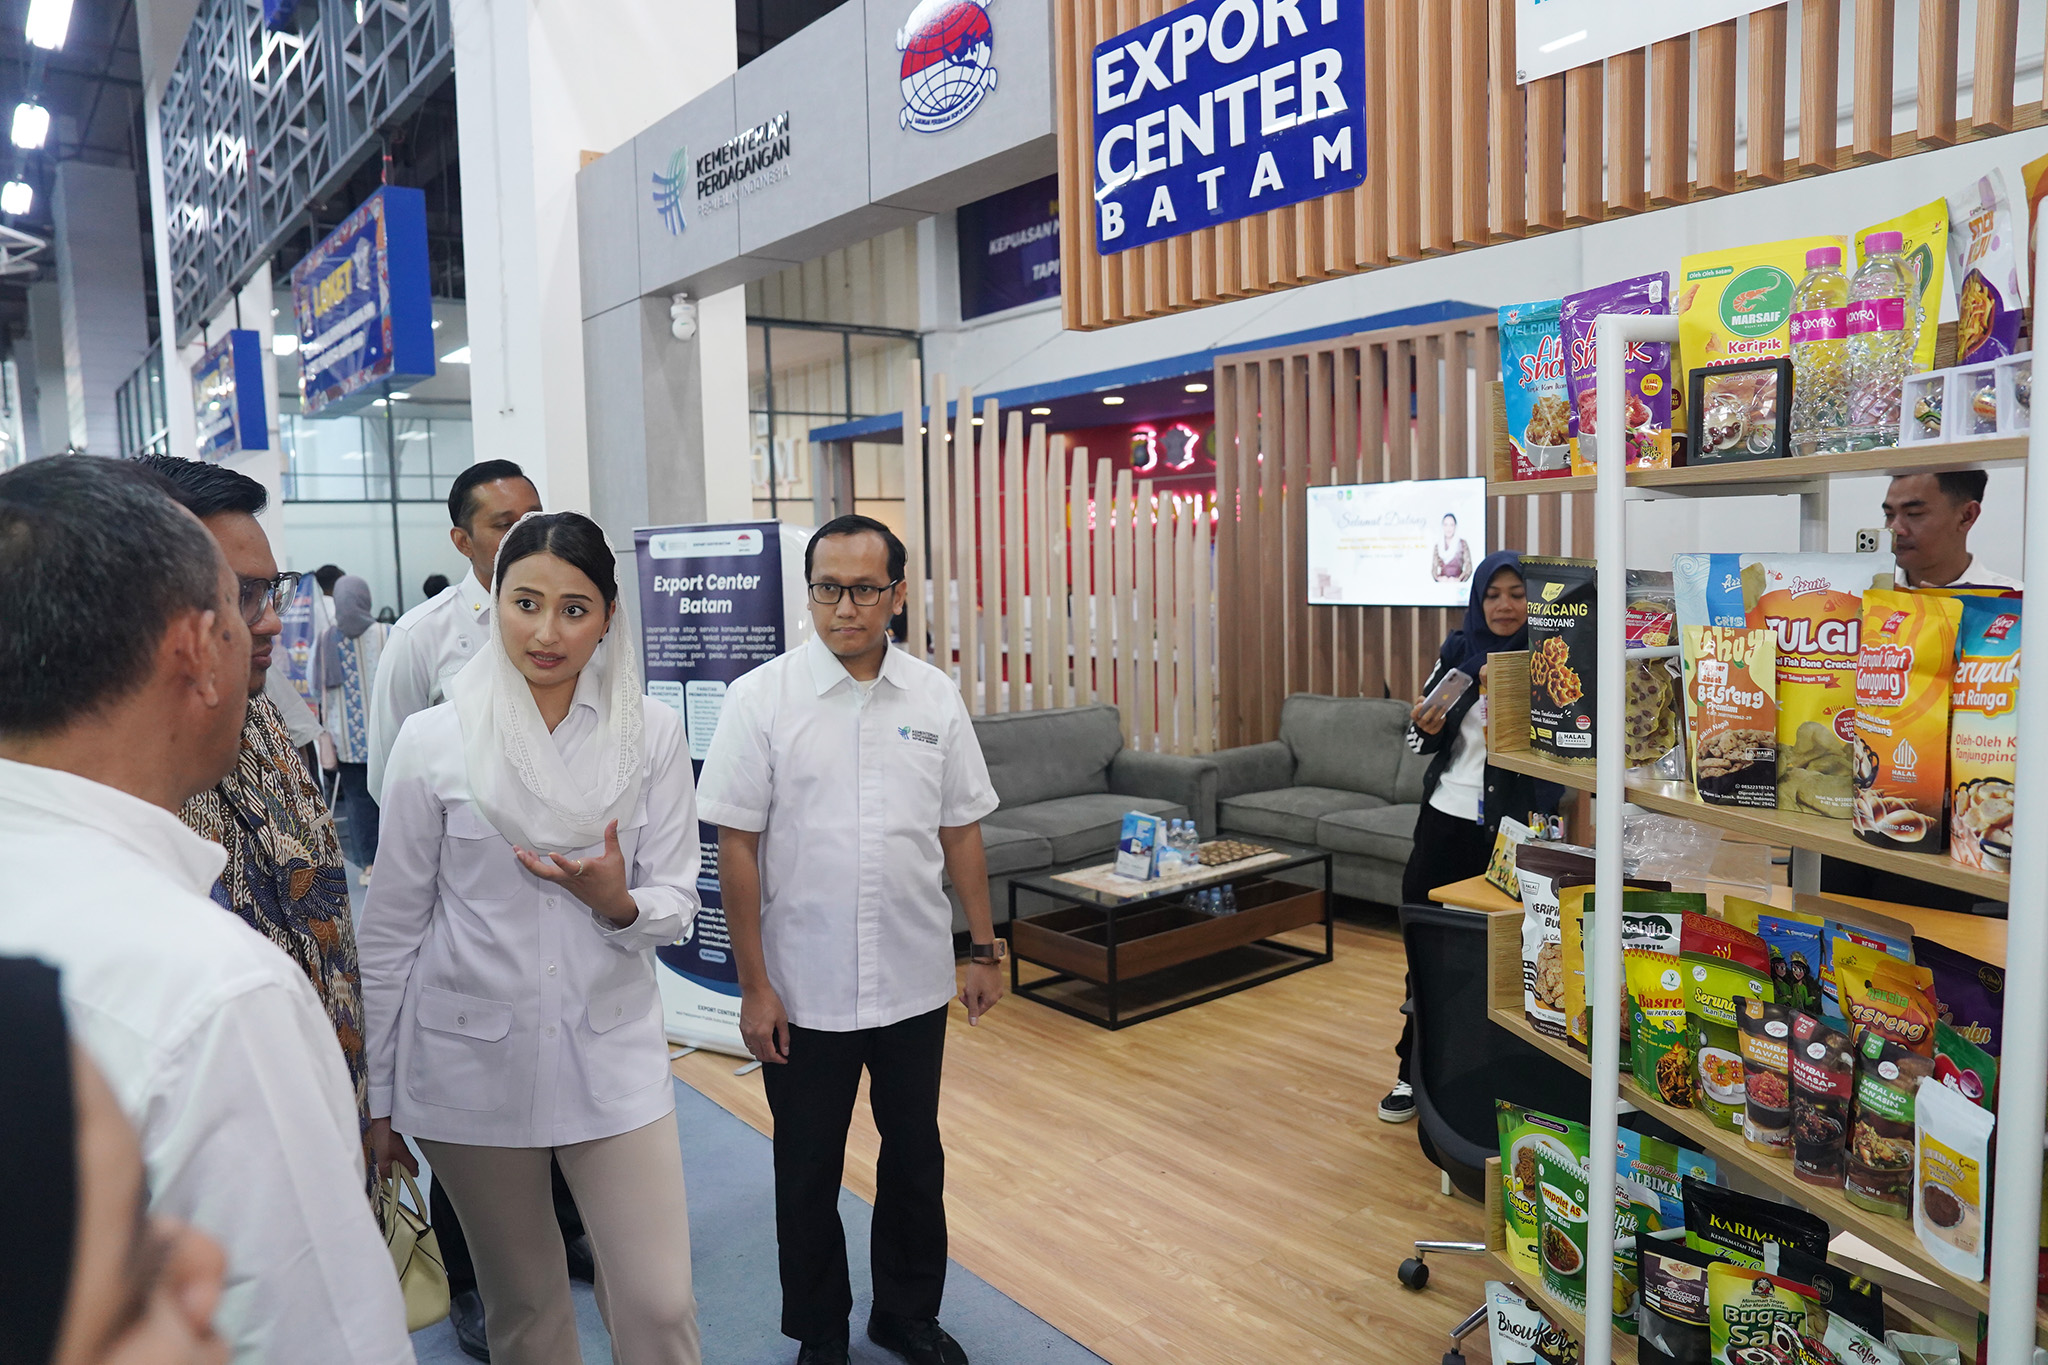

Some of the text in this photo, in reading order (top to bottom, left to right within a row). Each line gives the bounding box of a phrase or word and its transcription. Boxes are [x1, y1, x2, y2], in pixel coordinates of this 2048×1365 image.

[1097, 48, 1349, 187] CENTER
[696, 110, 789, 178] KEMENTERIAN
[697, 135, 790, 200] PERDAGANGAN
[1101, 125, 1353, 242] BATAM
[988, 220, 1052, 255] KEPUASAN
[1731, 311, 1781, 326] MARSAIF
[1802, 317, 1837, 329] OXYRA
[1849, 309, 1875, 322] OXYRA
[1504, 321, 1560, 337] WELCOME
[1728, 339, 1782, 354] Keripik
[1337, 511, 1427, 529] Selamat Datang
[653, 573, 761, 597] Export Center
[679, 597, 732, 614] Batam
[683, 626, 697, 634] stop
[721, 625, 748, 633] konsultasi
[751, 626, 776, 634] kepada
[1765, 618, 1858, 653] TULGI
[732, 643, 776, 651] permasalahan
[1784, 657, 1800, 667] Fish
[1800, 658, 1822, 668] Bone
[1856, 668, 1900, 696] Gonggong
[1697, 684, 1764, 709] Basreng
[1967, 689, 2008, 711] Ranga
[1956, 733, 2001, 748] Oleh-Oleh
[1891, 769, 1917, 777] HALAL
[697, 1004, 736, 1017] EXPORT CENTER
[1704, 1006, 1718, 1015] Ikan
[1797, 1026, 1807, 1034] Eat
[1799, 1017, 1815, 1028] Ready
[1868, 1037, 1883, 1047] Ready
[1806, 1071, 1837, 1088] ASAP
[1810, 1082, 1829, 1092] Sambal
[1875, 1094, 1899, 1108] ASIN
[1889, 1092, 1907, 1104] IJO
[1882, 1105, 1905, 1117] Sambal
[1630, 1160, 1655, 1173] Pisang
[1947, 1158, 1967, 1181] PATIN
[1865, 1186, 1876, 1194] 100
[1570, 1204, 1582, 1218] AS
[1710, 1232, 1764, 1257] KENIKMATAN TIADA
[1724, 1305, 1805, 1329] Bugar
